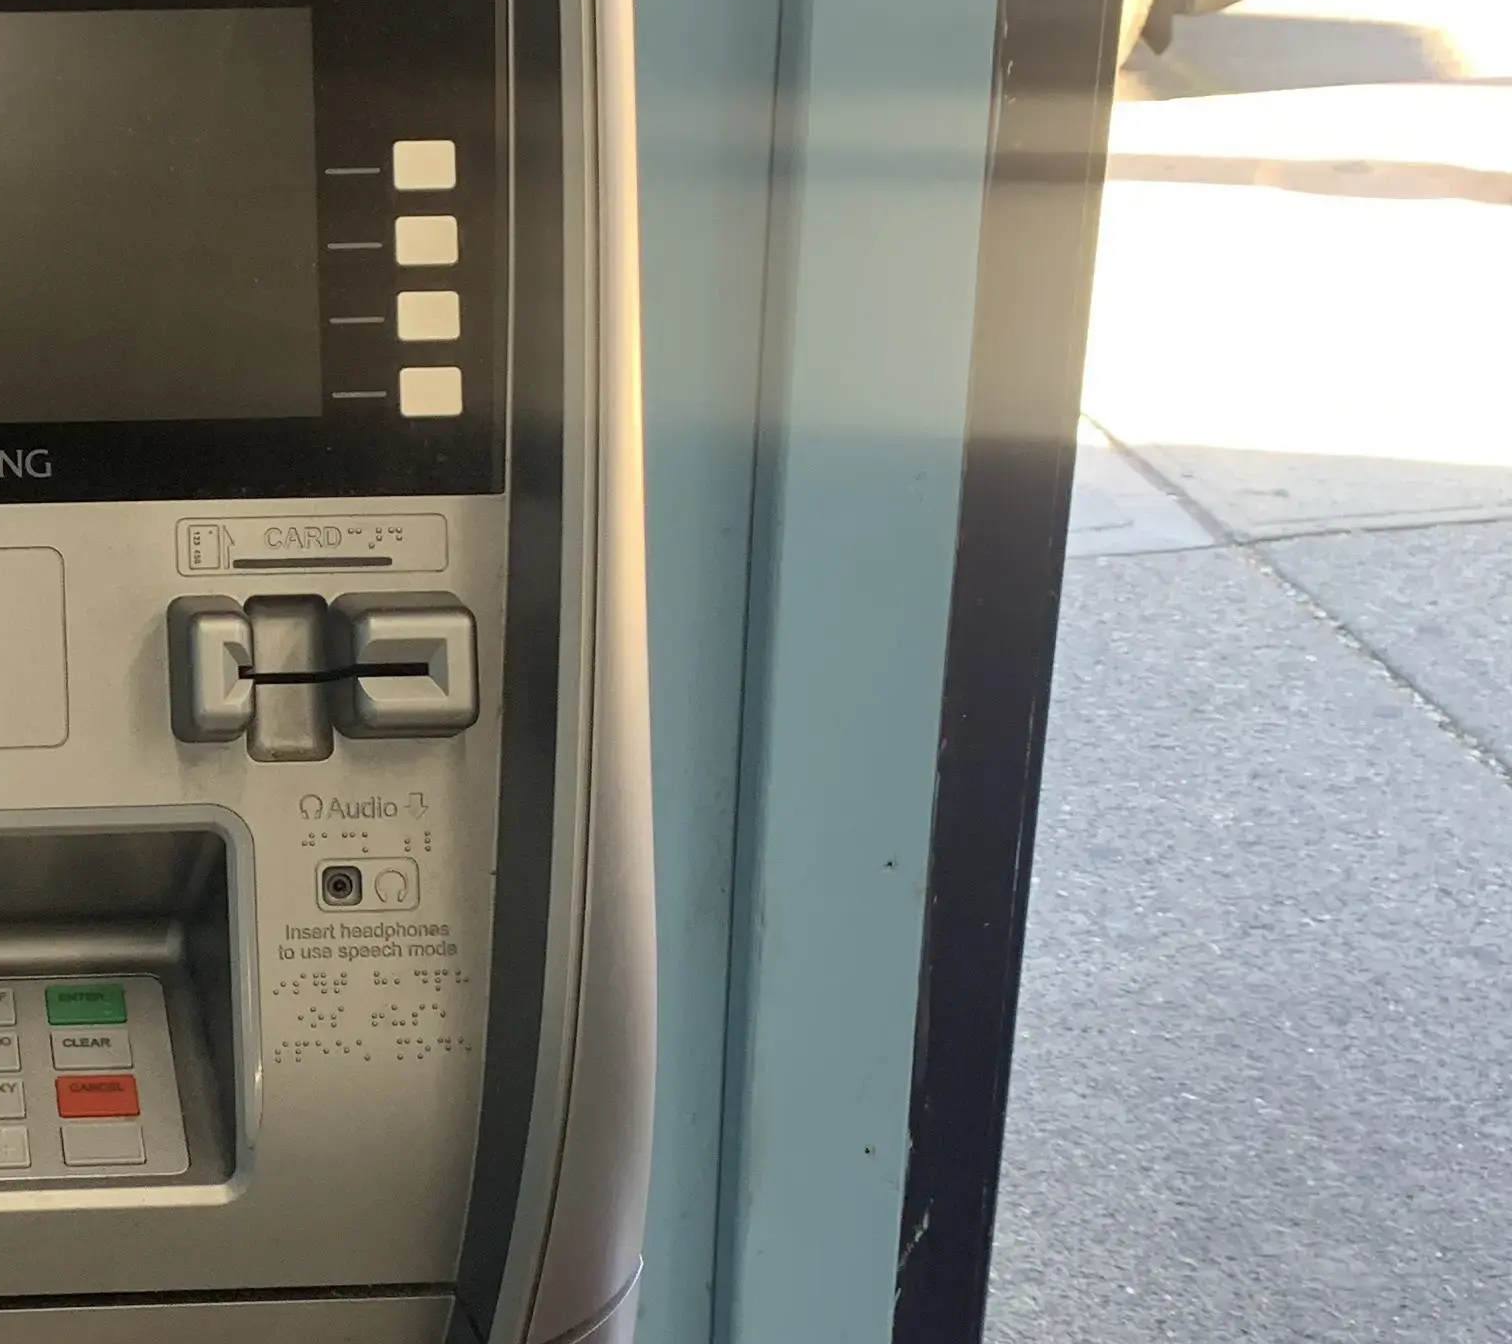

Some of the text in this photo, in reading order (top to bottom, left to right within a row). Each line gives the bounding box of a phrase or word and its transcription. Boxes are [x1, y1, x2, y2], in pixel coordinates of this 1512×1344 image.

[264, 526, 341, 550] CARD
[329, 796, 399, 820] Audio
[285, 921, 451, 942] Insert headphones
[278, 941, 458, 962] to use speech mode
[62, 1037, 111, 1047] CLEAR
